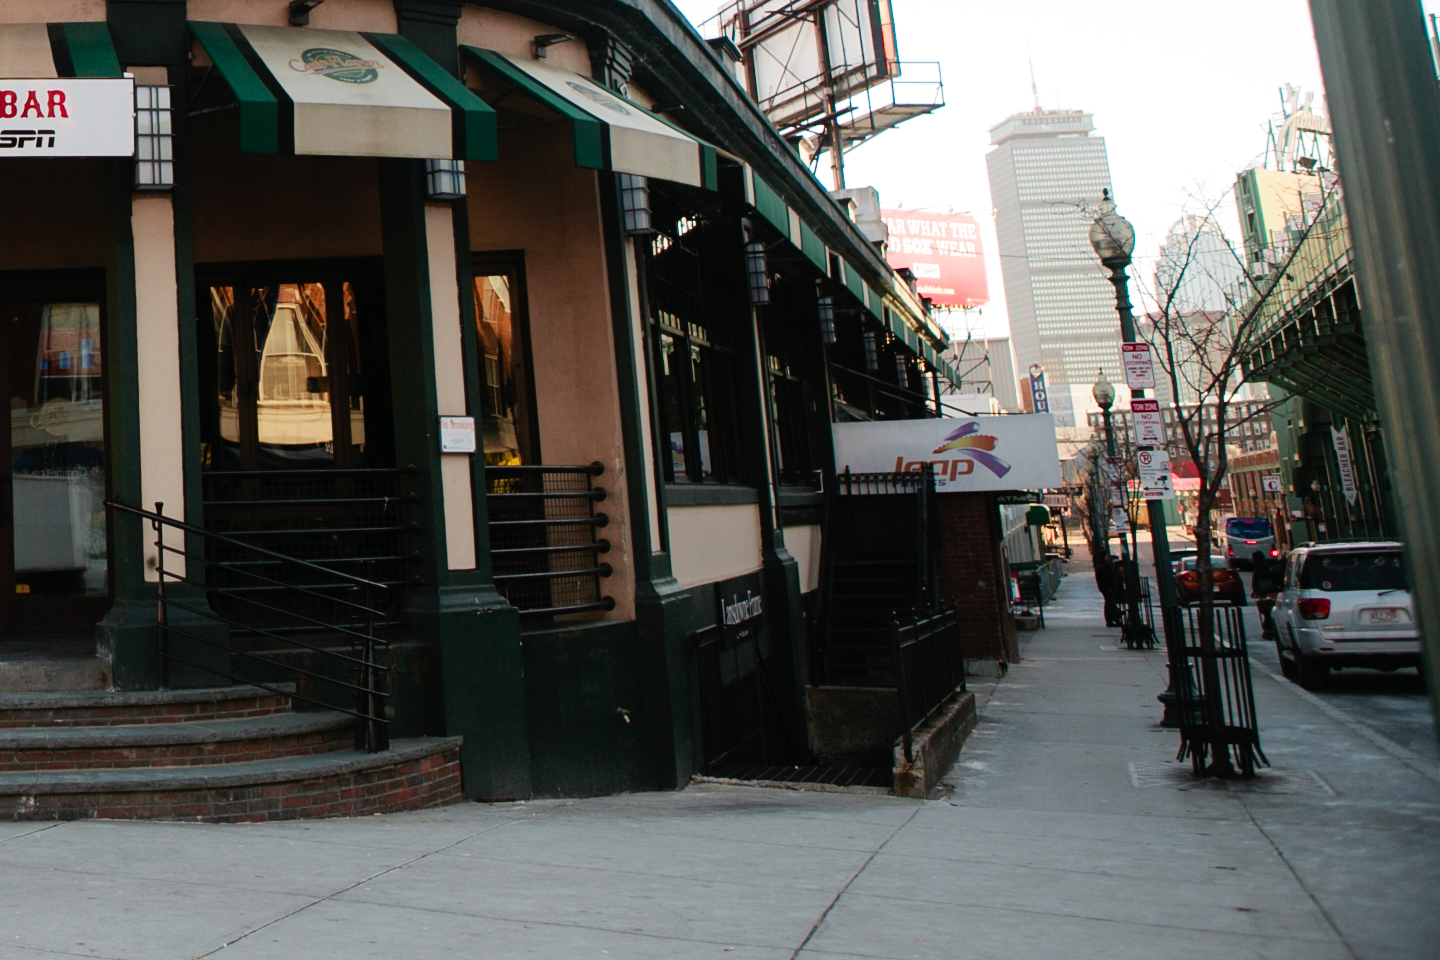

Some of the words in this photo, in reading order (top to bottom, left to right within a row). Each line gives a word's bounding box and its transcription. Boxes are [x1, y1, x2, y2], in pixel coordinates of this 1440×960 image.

[907, 220, 947, 237] WHAT
[950, 222, 977, 239] THE
[902, 238, 933, 254] SOX
[936, 240, 977, 257] WEAR
[1132, 403, 1144, 411] TOW
[1144, 403, 1158, 411] ZONE
[1335, 436, 1347, 451] BAR
[894, 456, 975, 482] leap
[1340, 453, 1354, 492] BLEACHER
[1268, 480, 1279, 492] C
